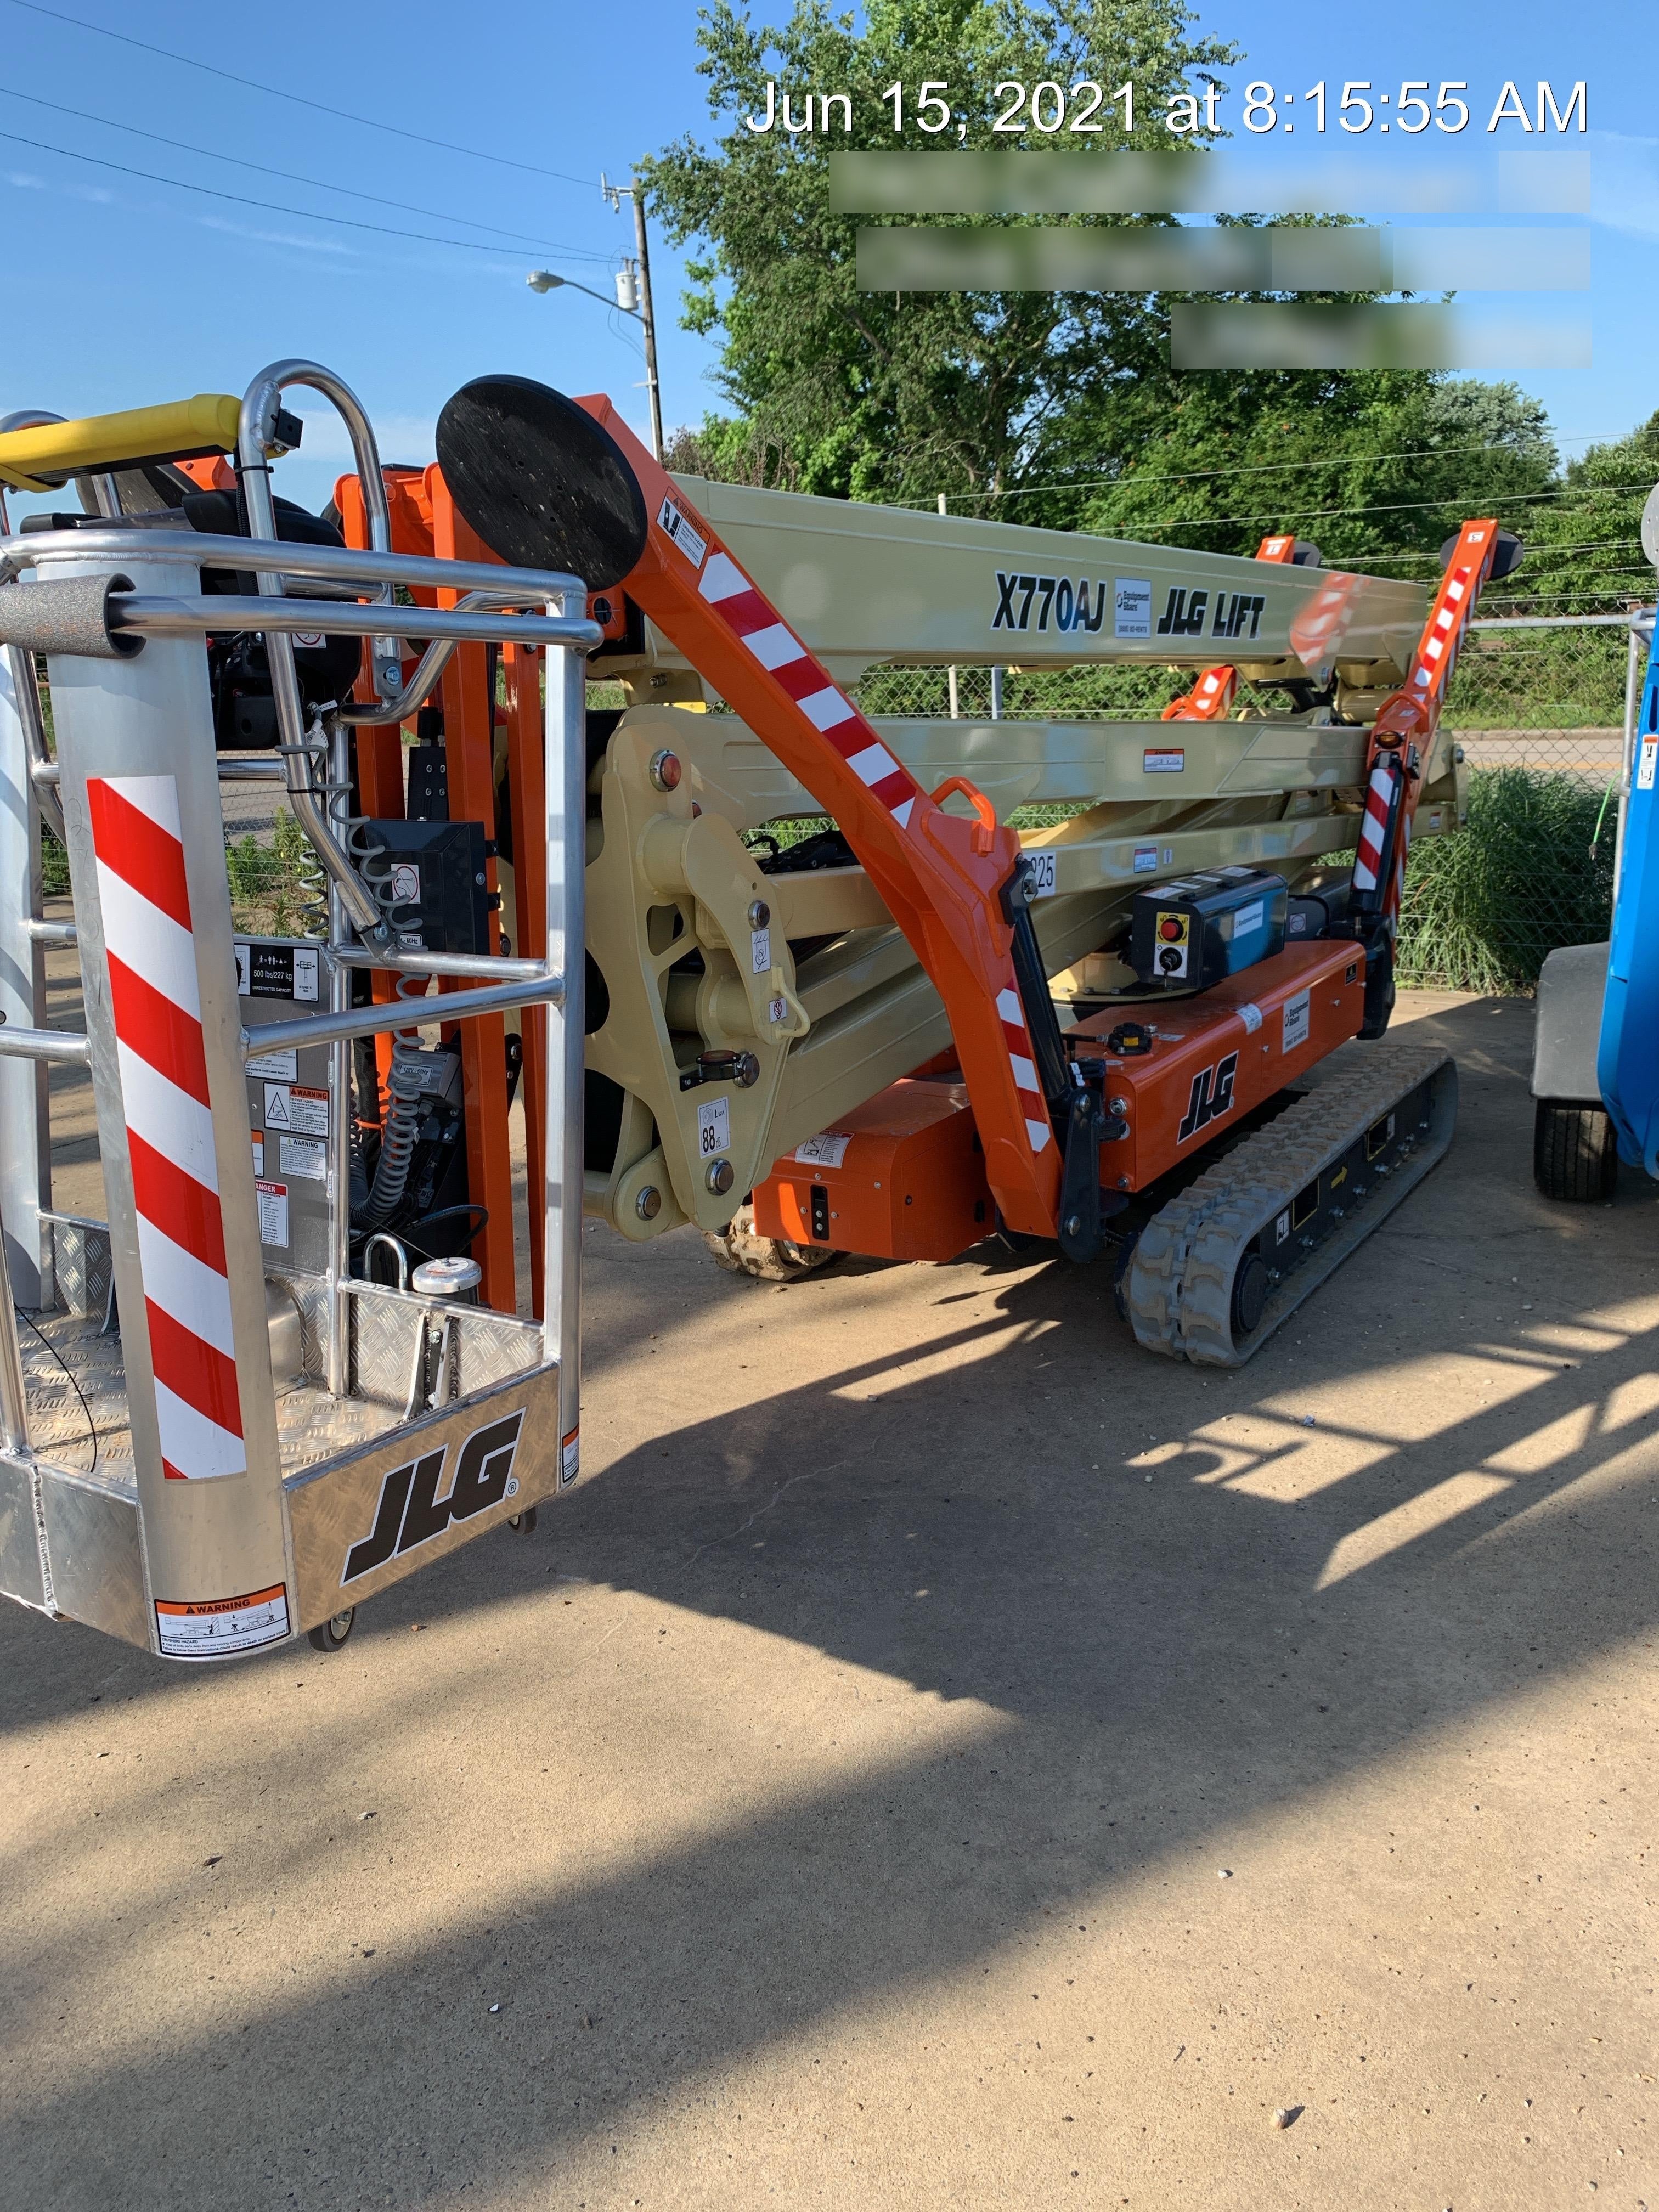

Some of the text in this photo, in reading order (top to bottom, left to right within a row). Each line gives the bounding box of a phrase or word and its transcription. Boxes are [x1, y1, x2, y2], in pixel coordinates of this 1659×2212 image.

[679, 502, 703, 534] WARNING
[990, 570, 1267, 640] X770AJ JLG LIFT
[253, 969, 292, 981] 500 lbs/227 kg
[297, 1088, 327, 1100] WARNING
[1176, 1049, 1239, 1146] JLG
[293, 1138, 319, 1149] WARNING
[703, 1125, 715, 1153] 88
[255, 1183, 276, 1193] ANGER
[339, 1406, 527, 1589] JLG
[196, 1599, 251, 1614] WARNING
